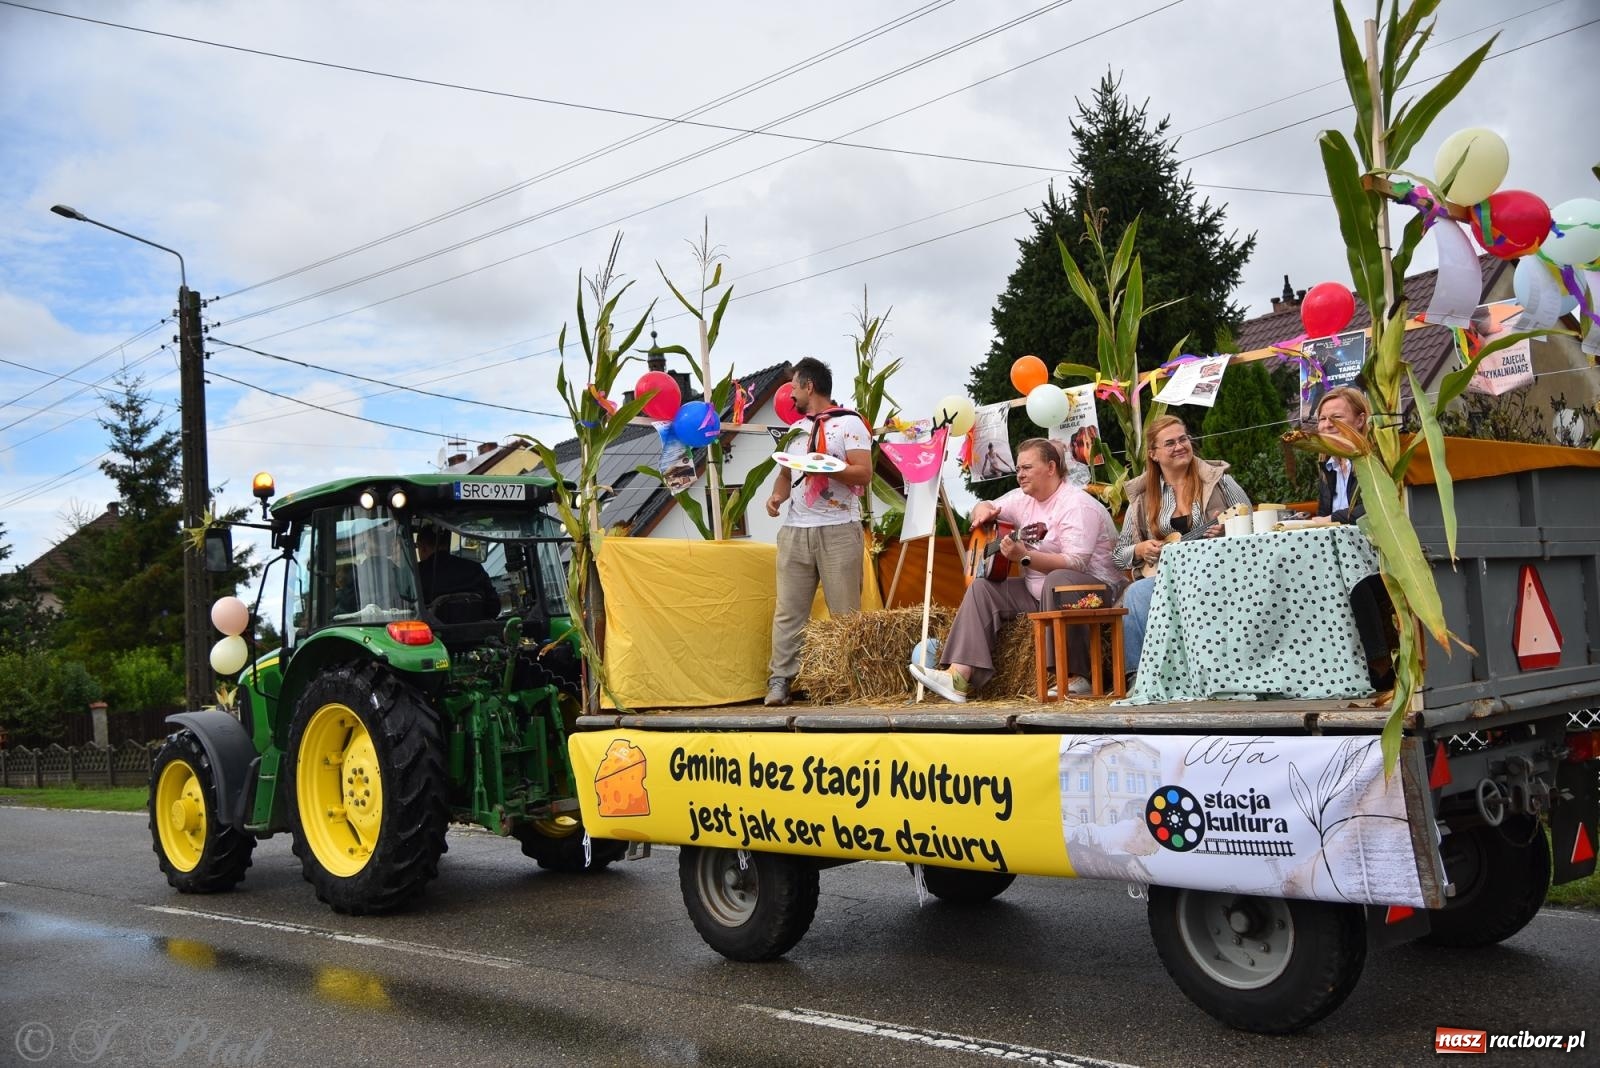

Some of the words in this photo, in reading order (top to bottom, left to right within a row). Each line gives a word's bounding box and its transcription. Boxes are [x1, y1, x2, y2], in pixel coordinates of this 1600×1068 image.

[462, 484, 490, 498] SRC
[494, 484, 523, 498] 9X77
[669, 747, 742, 787] Gmina
[749, 751, 795, 792] bez
[802, 755, 880, 809] Stacji
[890, 760, 1013, 821] Kultury
[1203, 787, 1271, 816] stacja
[1205, 810, 1289, 834] kultura
[689, 801, 737, 842] jest
[739, 807, 782, 848] jak
[784, 817, 826, 848] ser
[831, 815, 892, 853] bez
[895, 819, 1010, 873] dziury
